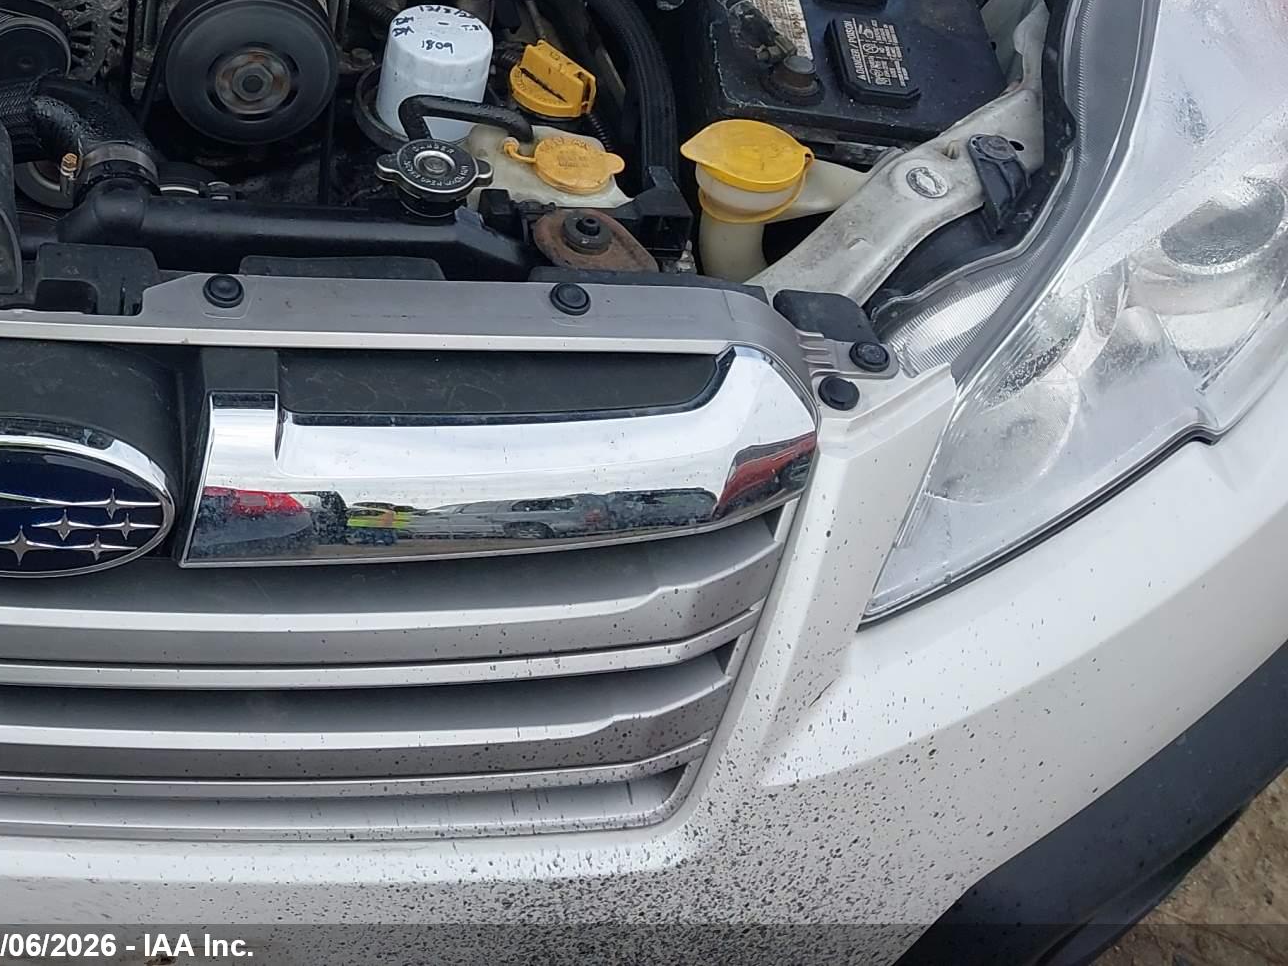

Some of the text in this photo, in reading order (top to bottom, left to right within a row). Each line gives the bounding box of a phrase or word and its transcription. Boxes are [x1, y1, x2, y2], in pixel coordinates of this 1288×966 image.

[843, 20, 859, 44] POISON
[420, 39, 454, 55] 1809
[850, 48, 866, 75] DANGER
